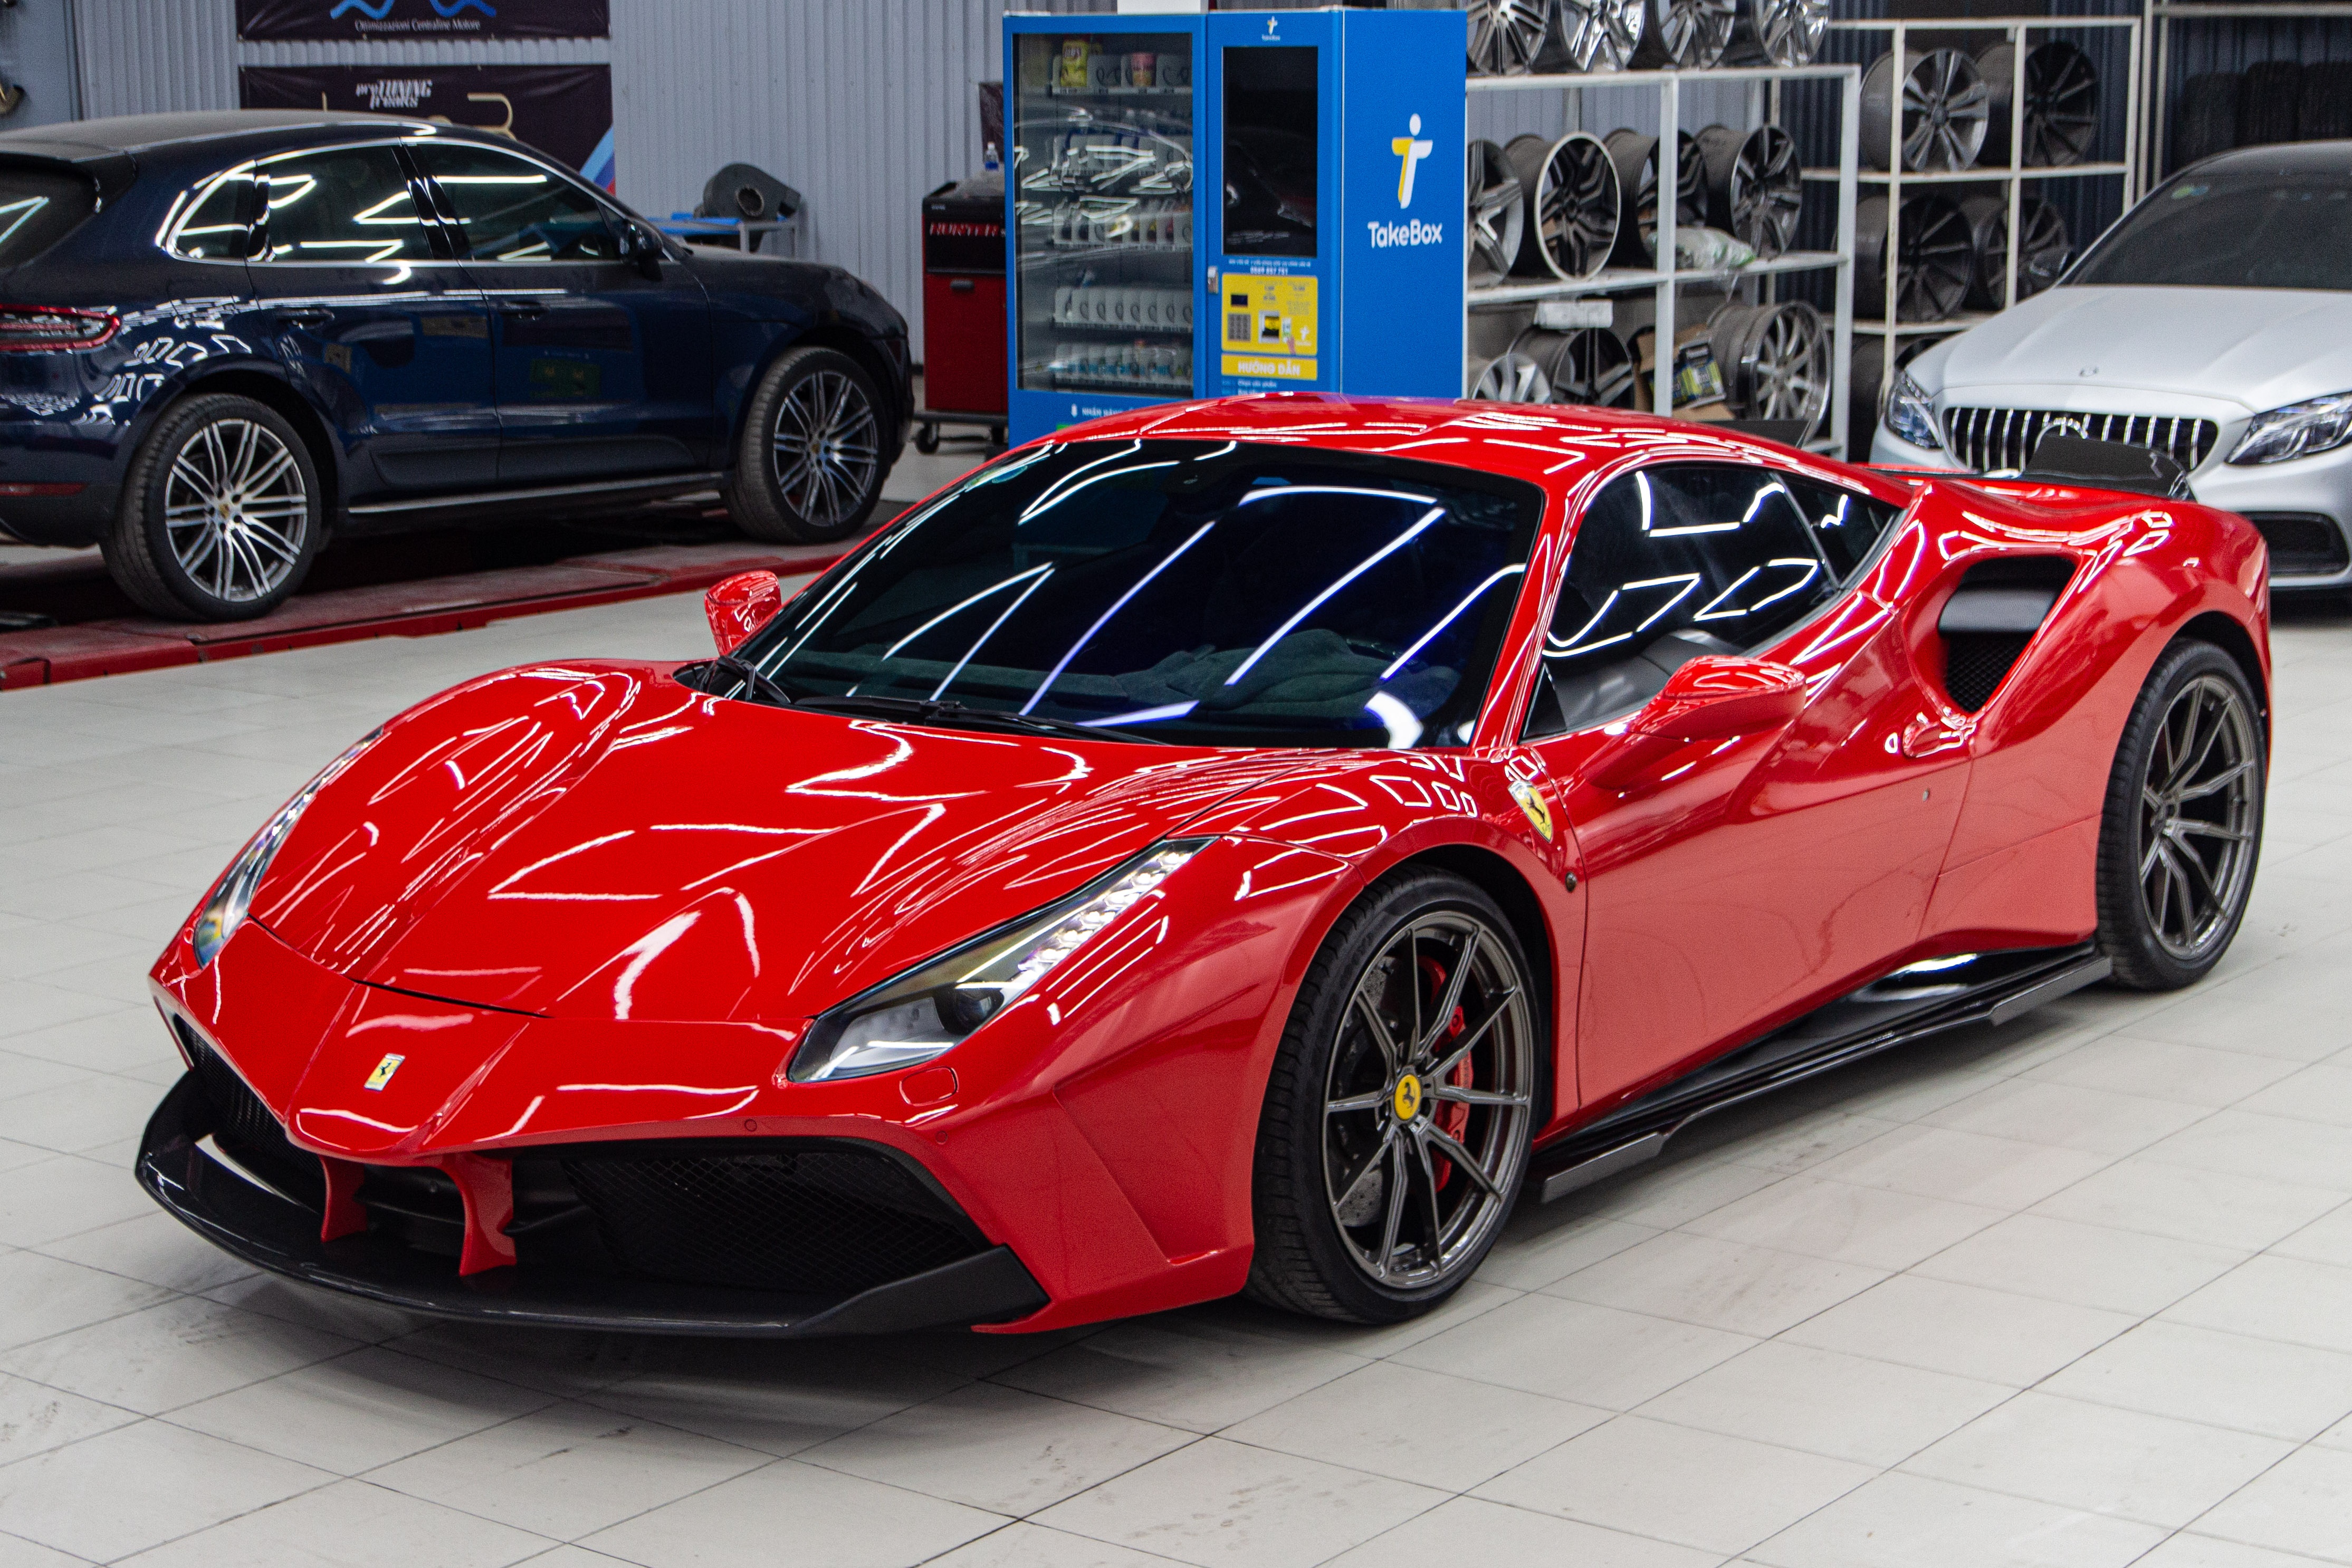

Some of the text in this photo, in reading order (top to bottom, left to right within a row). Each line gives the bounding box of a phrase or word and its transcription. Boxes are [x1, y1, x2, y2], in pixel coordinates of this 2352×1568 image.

[452, 18, 481, 31] Motore
[1367, 218, 1443, 248] TakeBox
[1238, 359, 1276, 374] HƯỚNG
